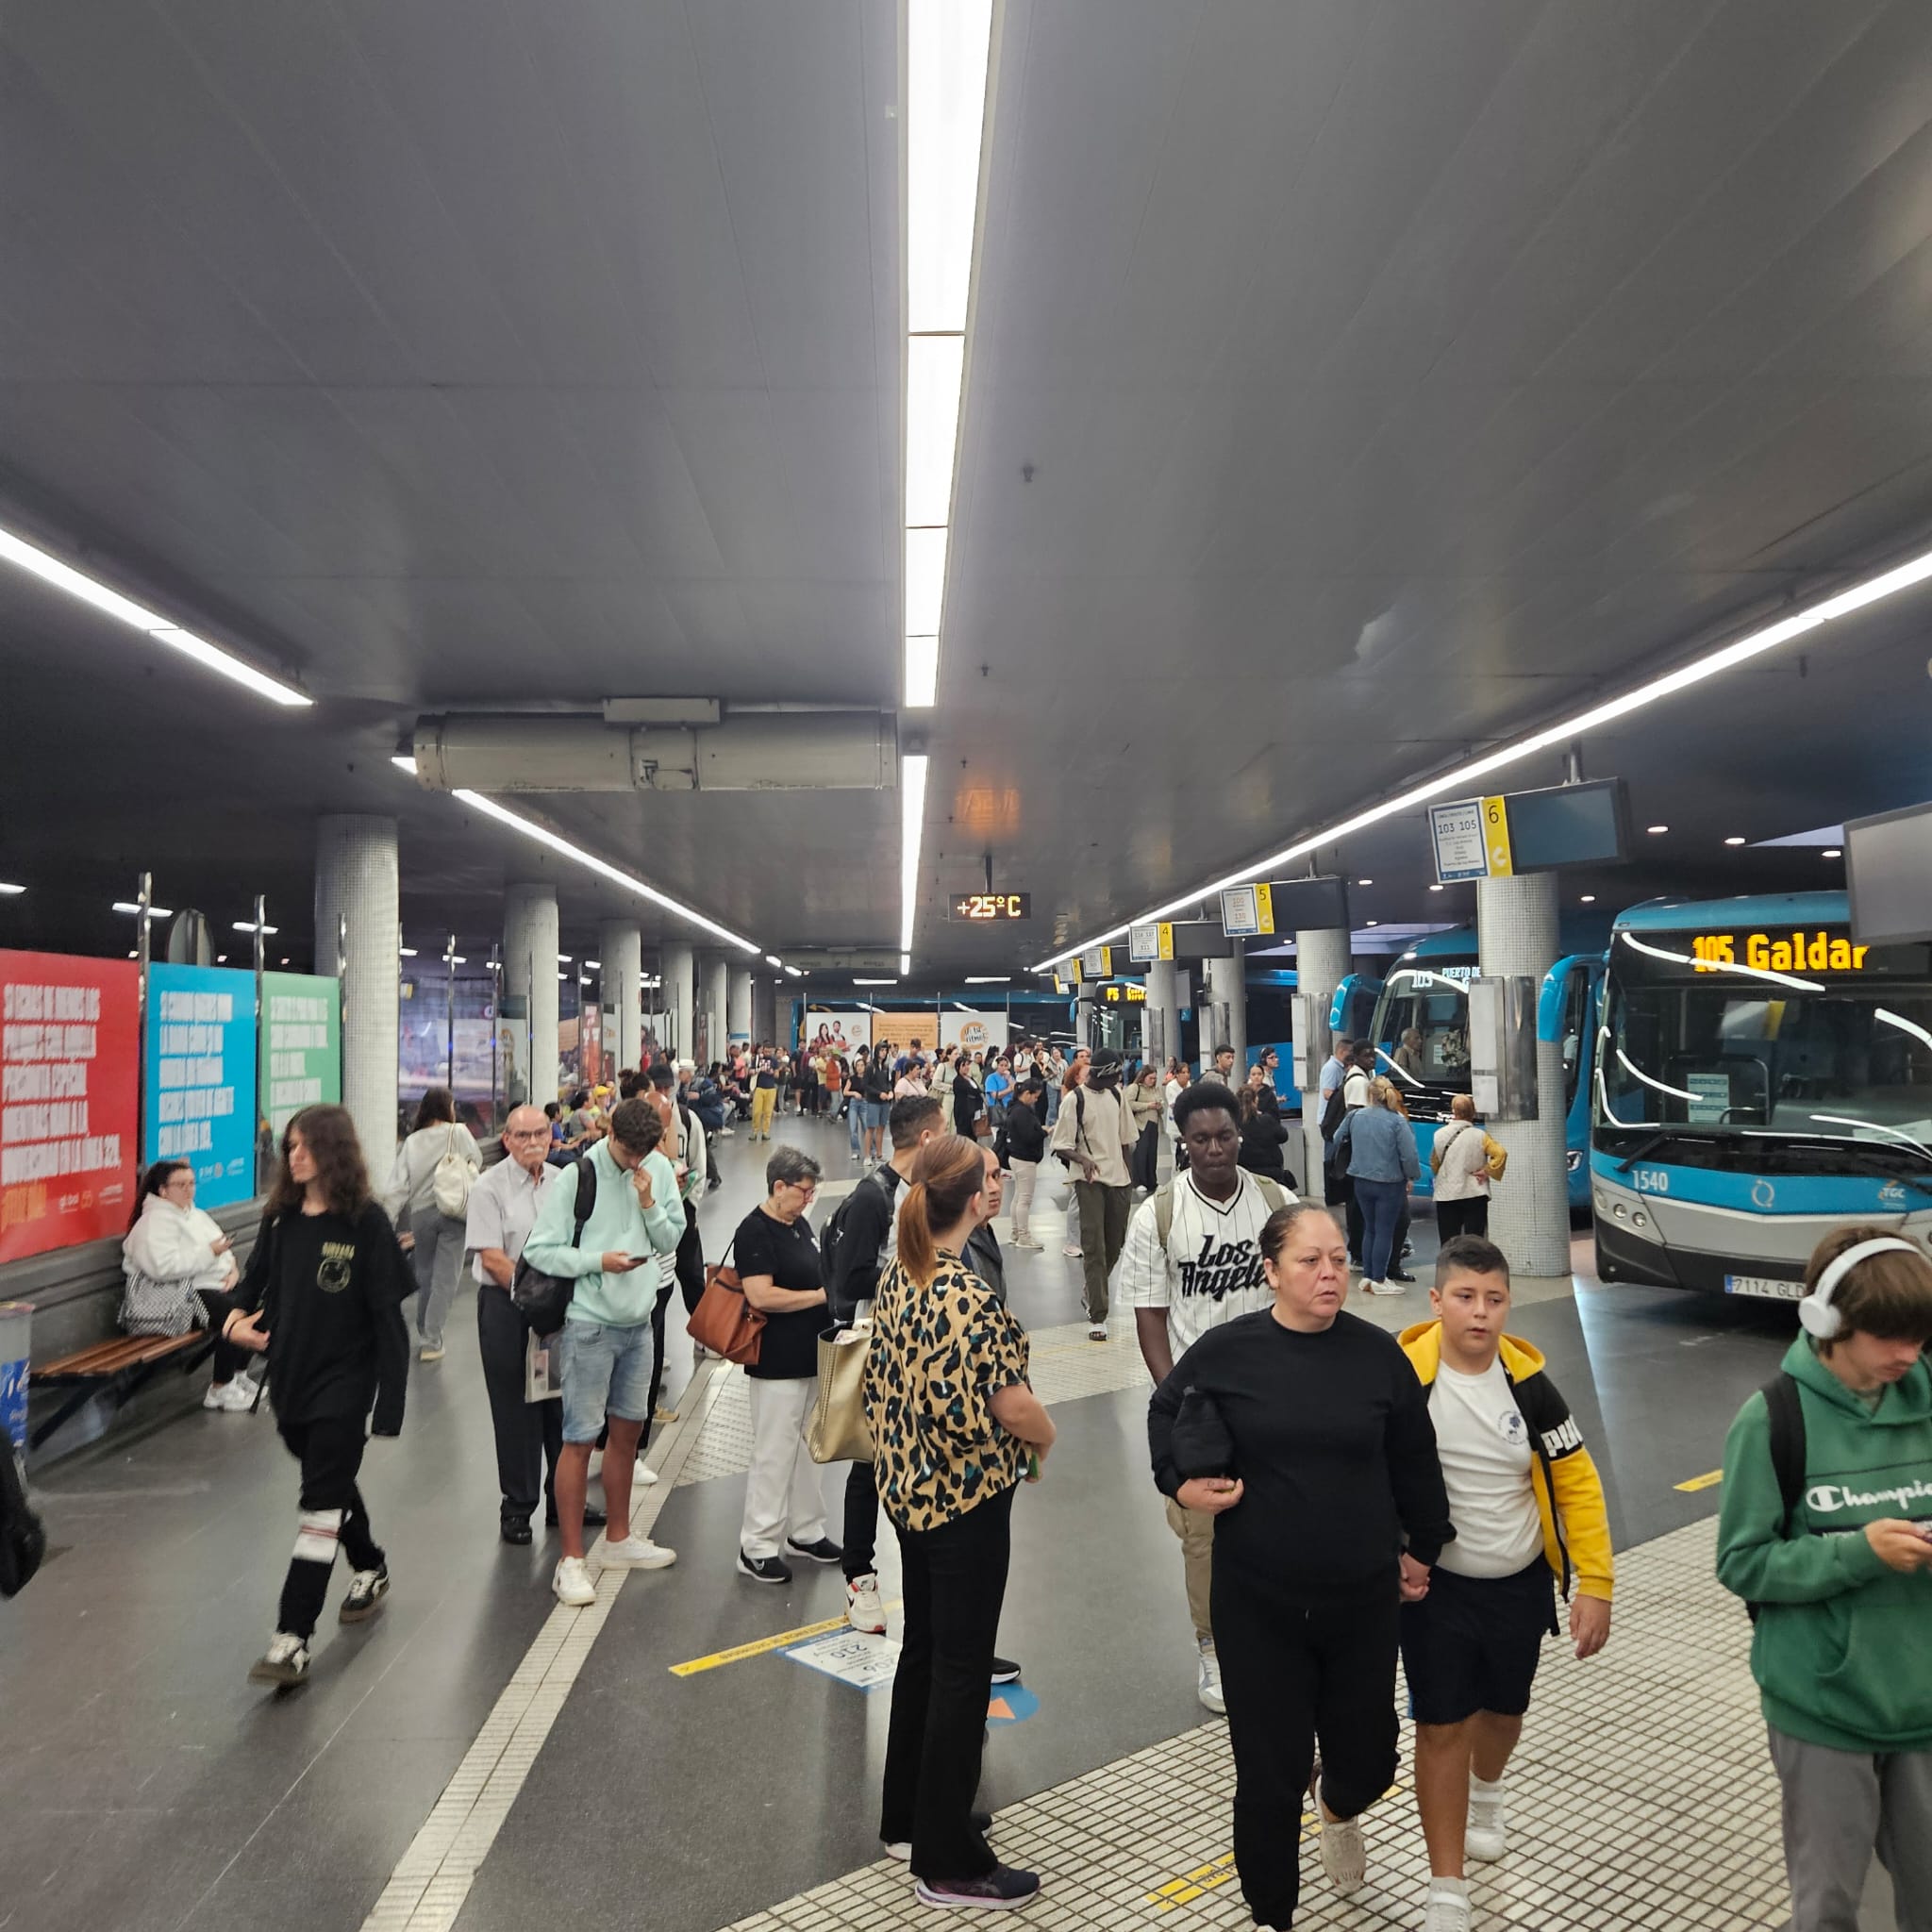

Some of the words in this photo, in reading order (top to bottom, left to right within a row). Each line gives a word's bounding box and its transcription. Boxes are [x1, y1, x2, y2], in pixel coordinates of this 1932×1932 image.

[1489, 805, 1499, 824] 6
[1438, 823, 1455, 834] 103
[1459, 820, 1477, 831] 105
[1259, 888, 1267, 901] 5
[1162, 926, 1170, 936] 4
[1692, 935, 1735, 973] 105
[1747, 931, 1871, 972] Galdar
[1412, 970, 1434, 989] 103
[1442, 967, 1471, 978] PUERTO
[1472, 966, 1481, 977] DE
[1632, 1170, 1669, 1191] 1540
[1197, 1234, 1254, 1268] Los
[1733, 1278, 1769, 1294] 7114
[830, 1644, 867, 1658] 210
